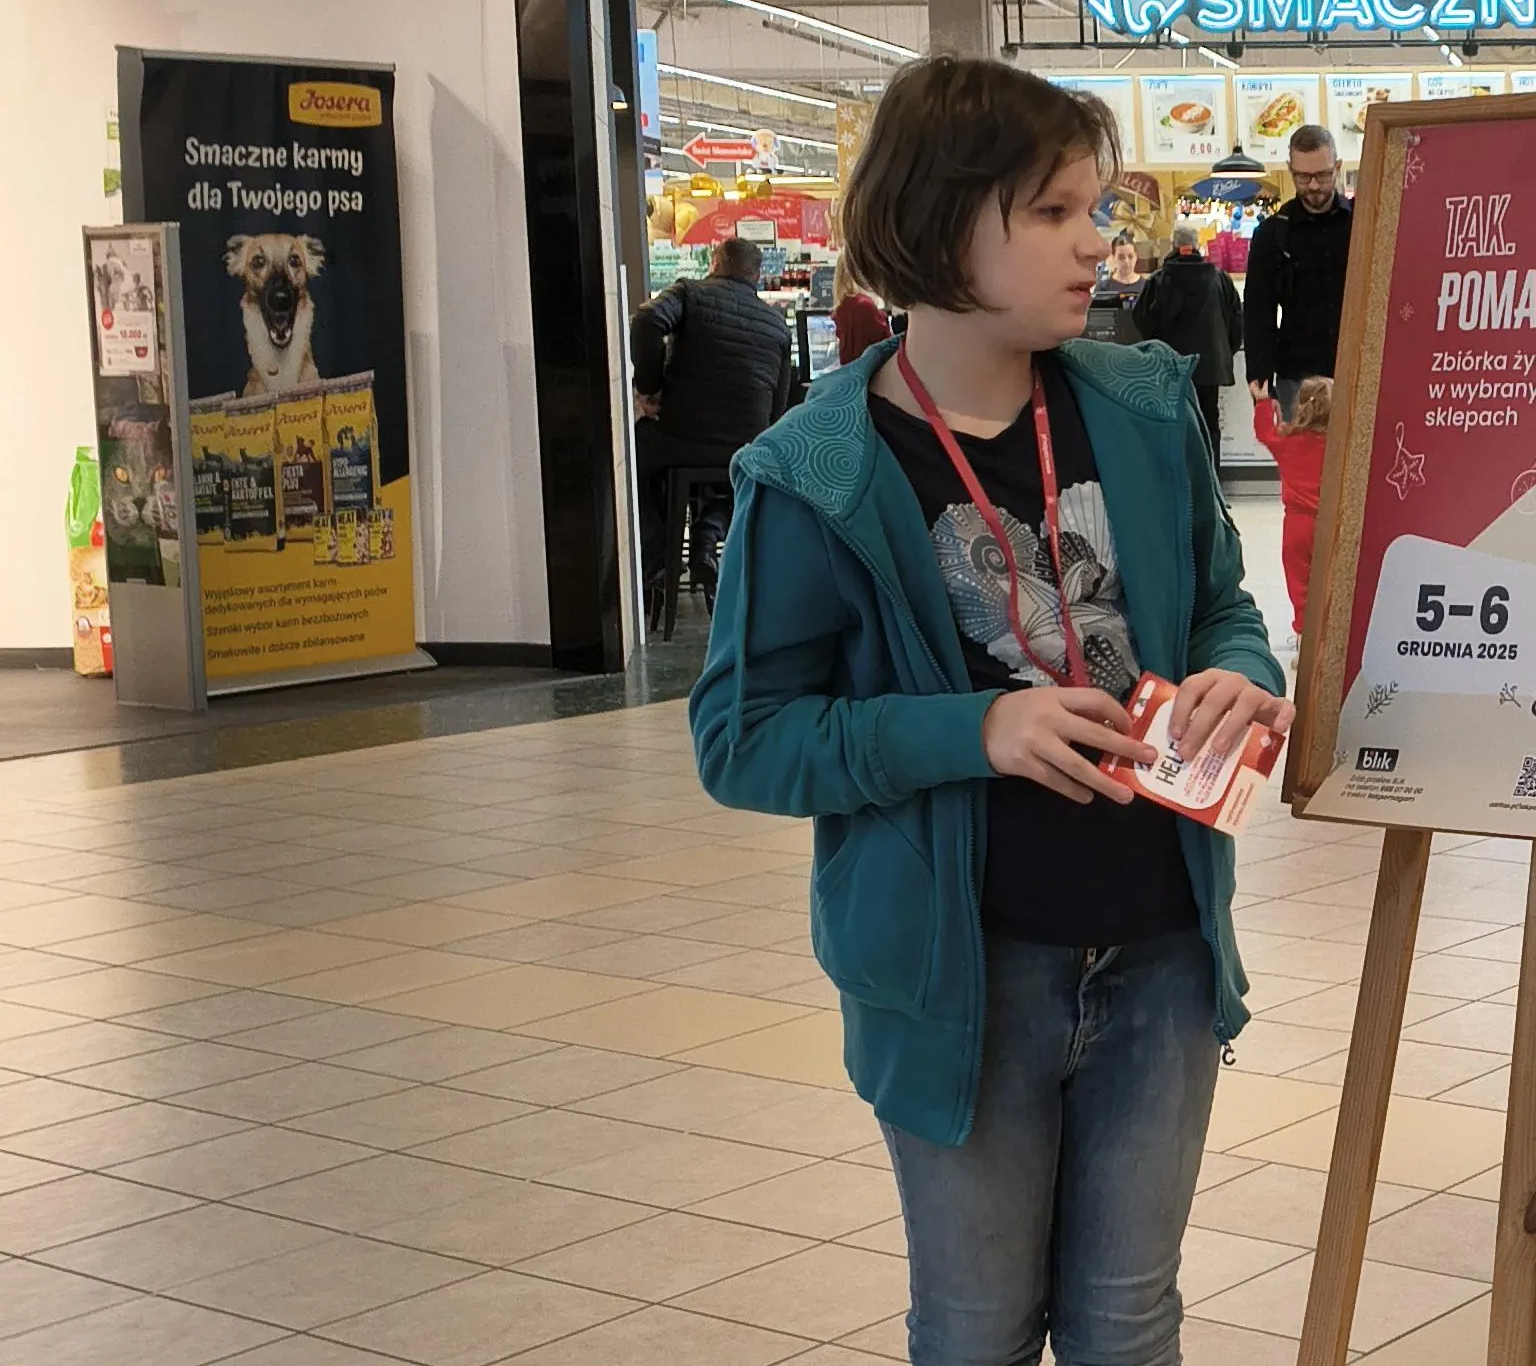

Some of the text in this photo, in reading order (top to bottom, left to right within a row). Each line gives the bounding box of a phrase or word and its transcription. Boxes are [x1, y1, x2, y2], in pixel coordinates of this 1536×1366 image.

[299, 88, 371, 112] Josera
[184, 135, 364, 176] Smaczne karmy
[186, 180, 364, 218] dla Twojego psa
[1445, 193, 1517, 258] TAK.
[1430, 349, 1508, 372] Zbiórka
[1428, 383, 1446, 399] w
[1424, 405, 1519, 433] sklepach
[313, 576, 337, 588] karm
[204, 599, 277, 615] dedykowanych
[275, 616, 300, 628] karm
[1396, 640, 1519, 660] GRUDNIA 2025
[1362, 750, 1392, 770] blik
